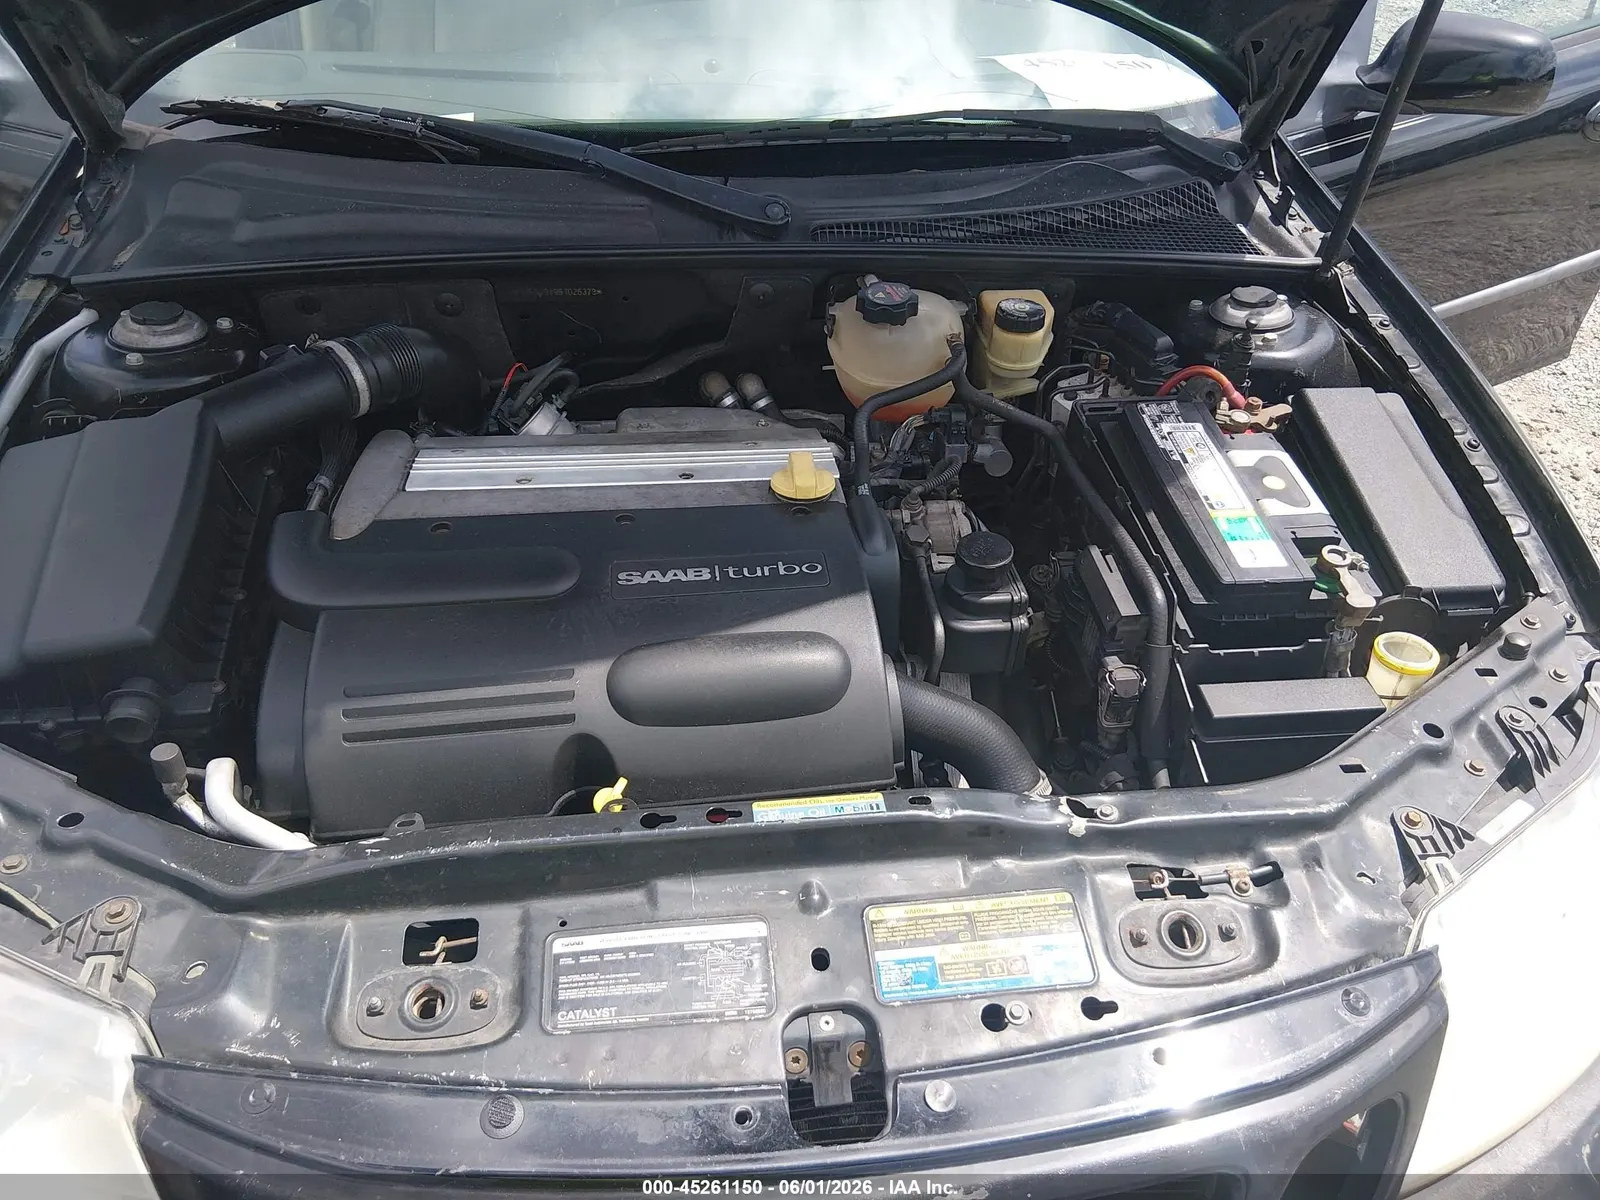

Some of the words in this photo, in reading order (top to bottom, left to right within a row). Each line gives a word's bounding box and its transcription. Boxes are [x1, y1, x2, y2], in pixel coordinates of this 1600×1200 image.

[617, 567, 711, 585] SAAB
[723, 561, 823, 579] turbo
[557, 1006, 618, 1022] CATALYST
